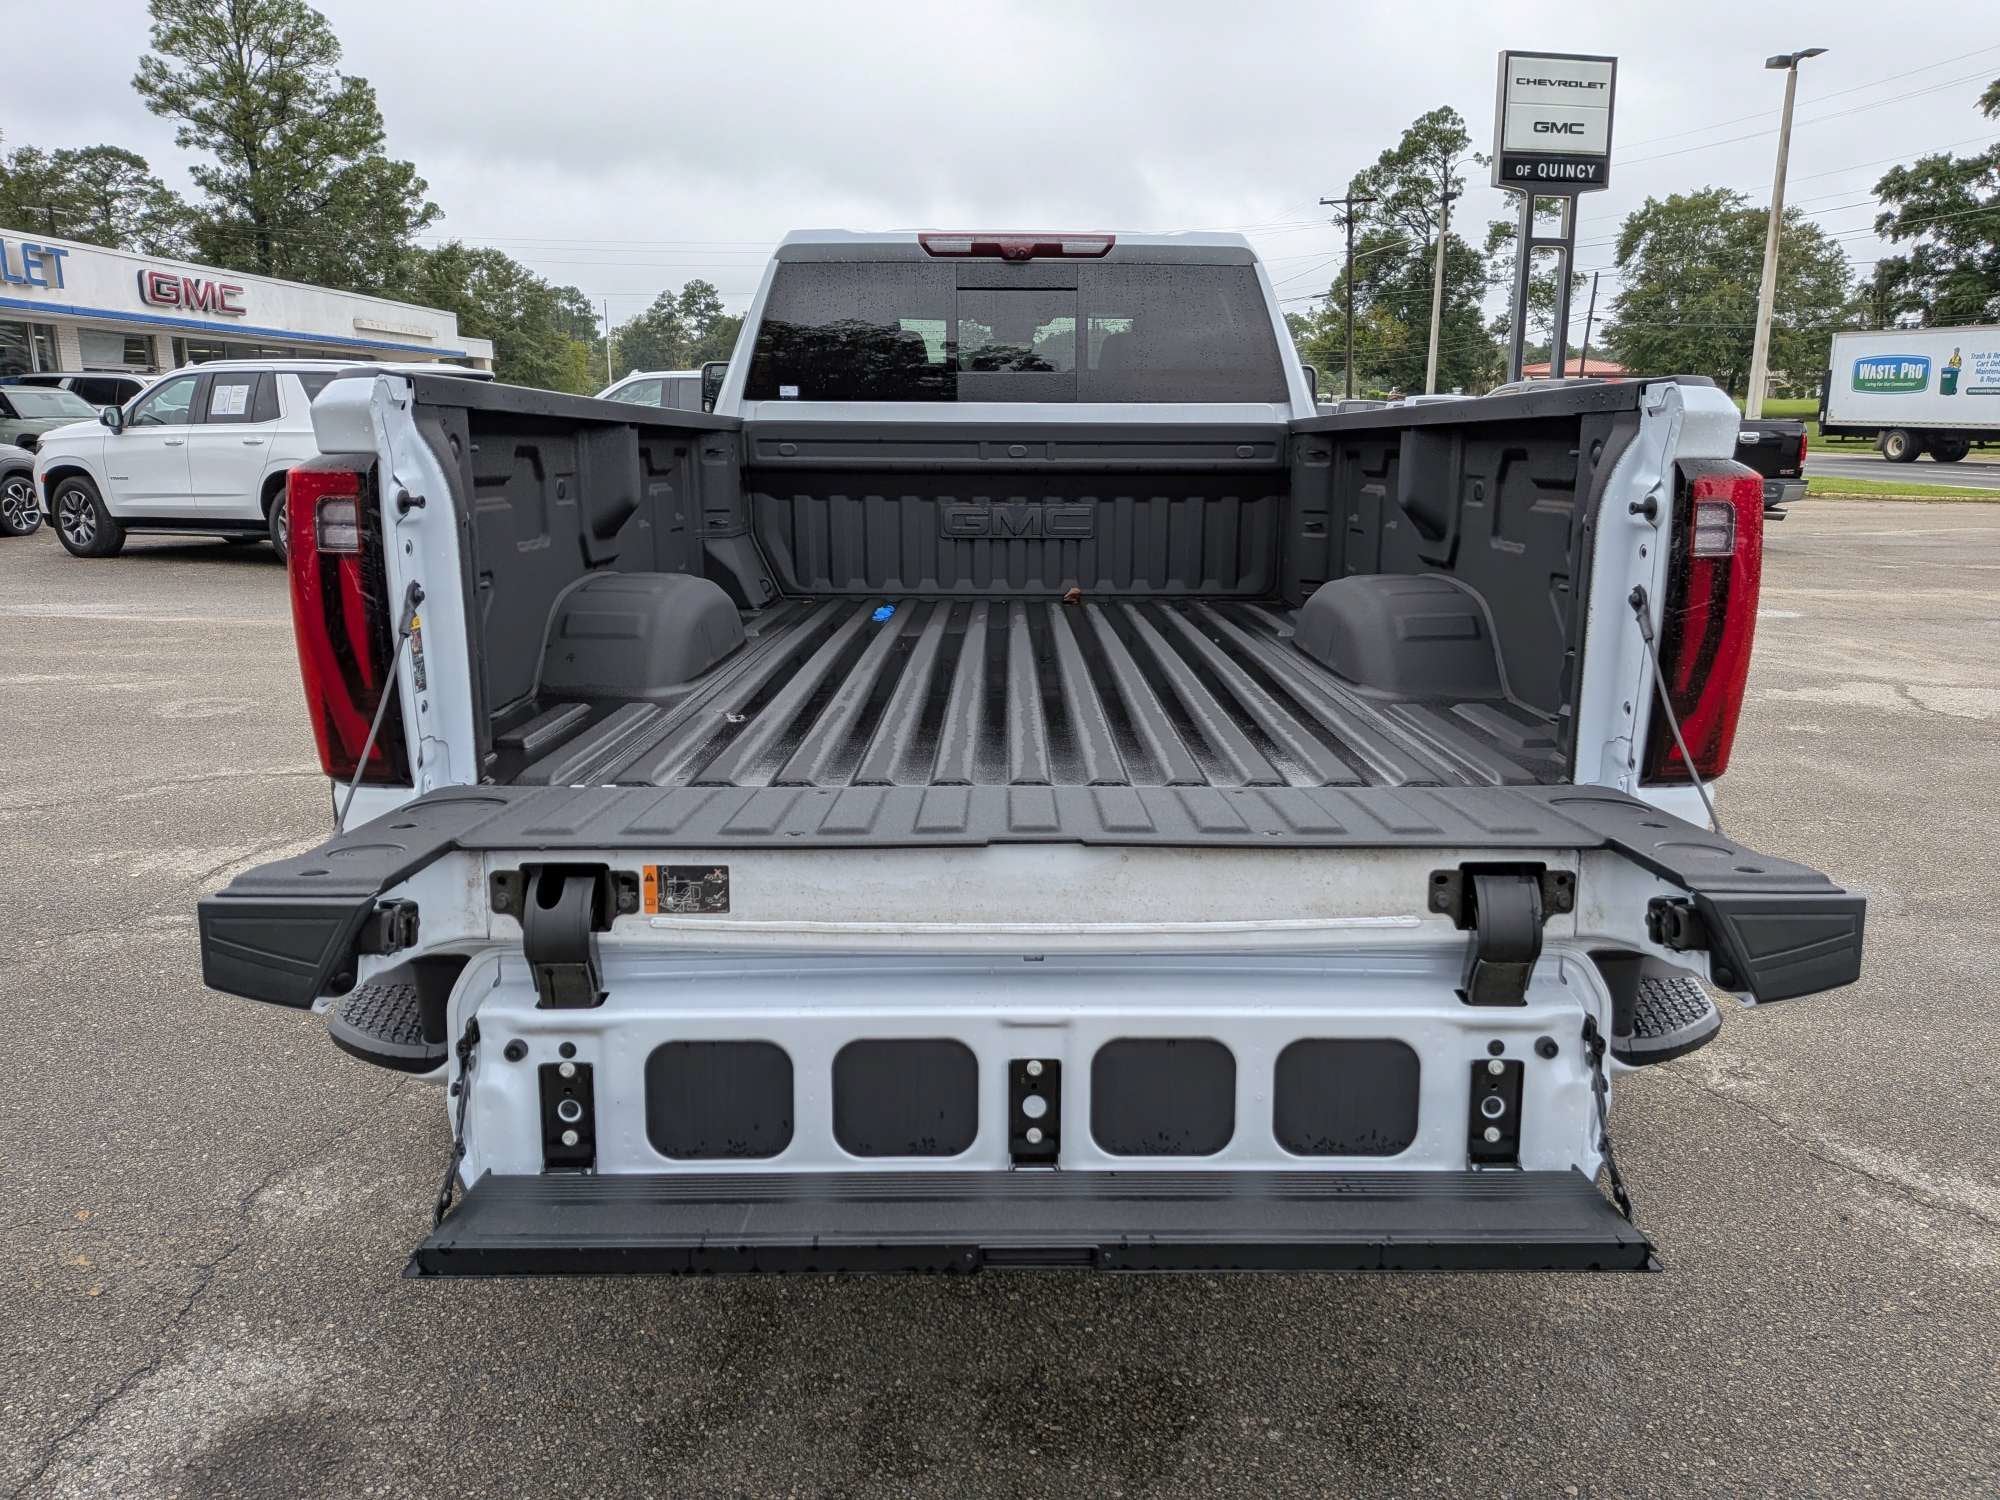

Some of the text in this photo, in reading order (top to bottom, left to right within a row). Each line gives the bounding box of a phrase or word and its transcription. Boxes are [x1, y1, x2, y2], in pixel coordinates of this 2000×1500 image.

[1515, 77, 1607, 90] CHEVROLET
[1533, 121, 1585, 135] GMC
[1515, 163, 1596, 179] OF QUINCY
[142, 270, 247, 316] GMC
[1859, 362, 1924, 380] WASTE PRO
[942, 504, 1093, 537] GMC
